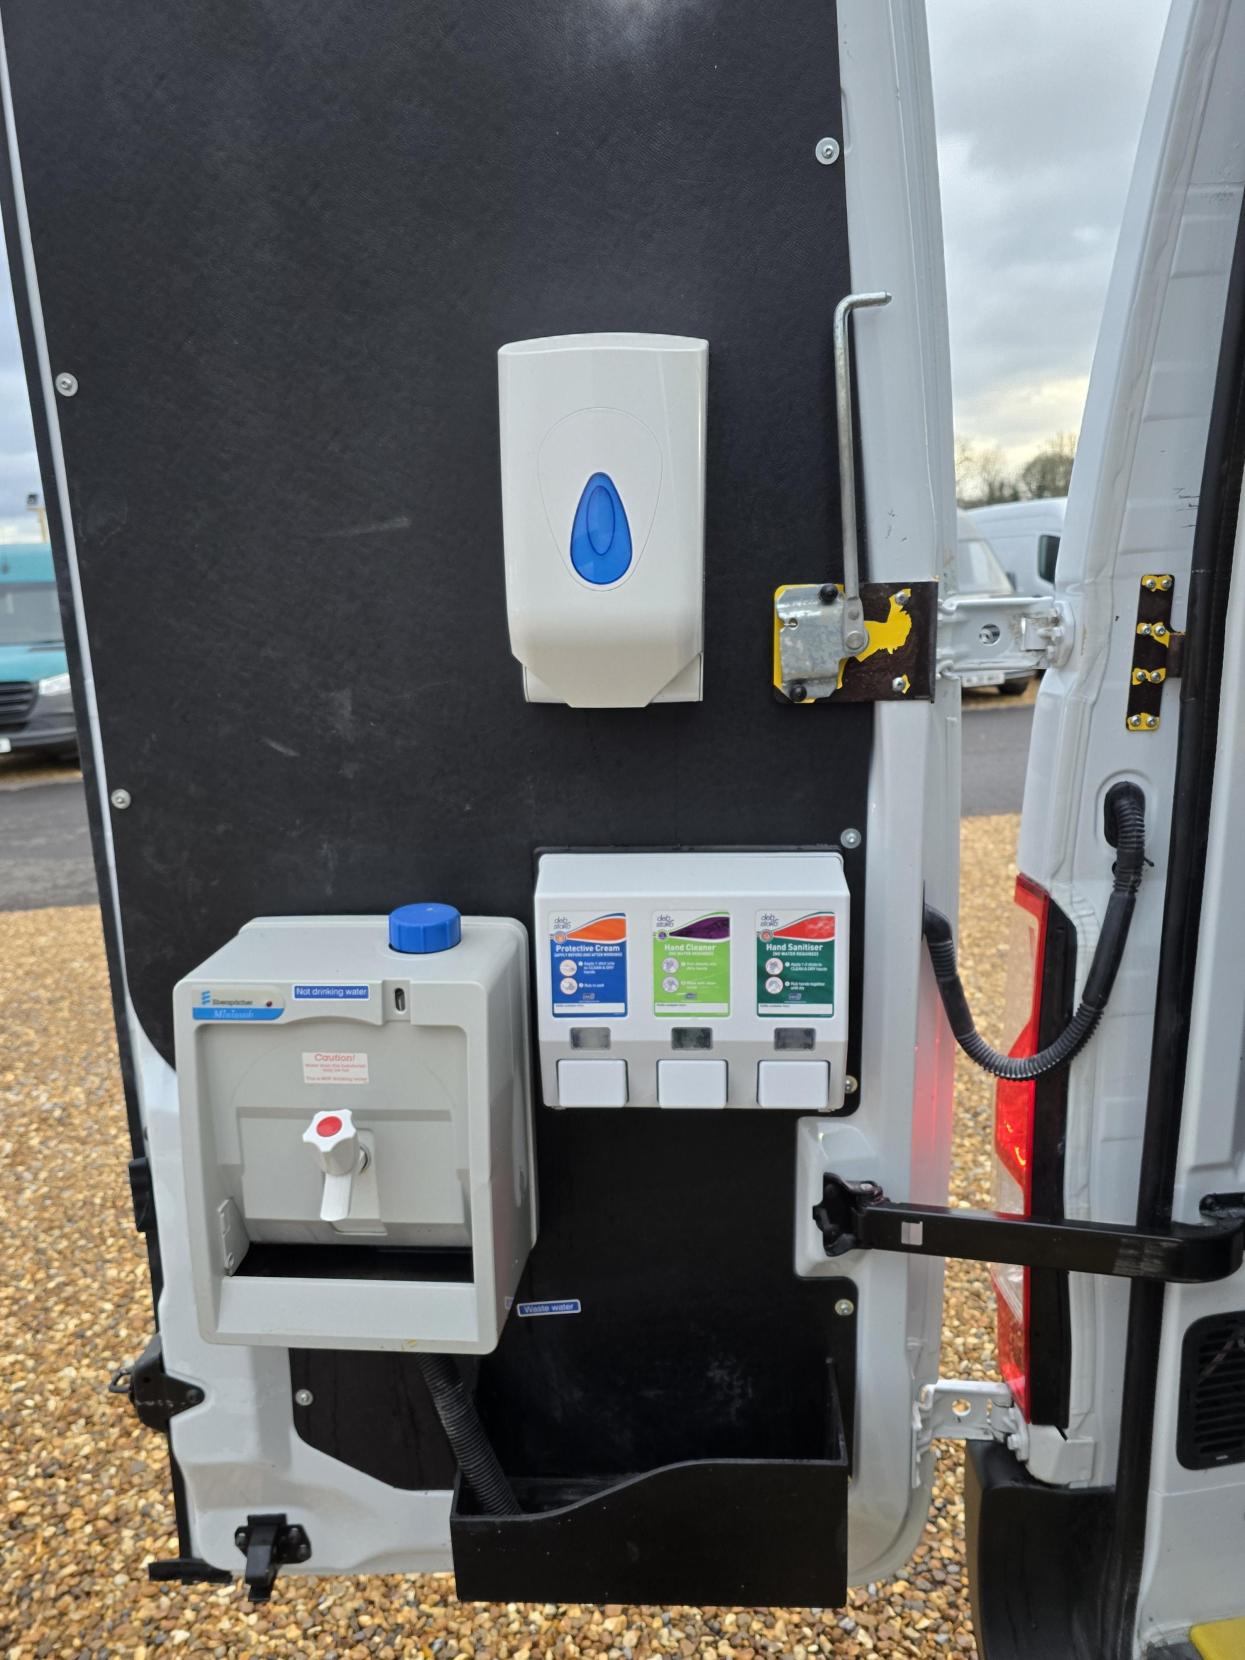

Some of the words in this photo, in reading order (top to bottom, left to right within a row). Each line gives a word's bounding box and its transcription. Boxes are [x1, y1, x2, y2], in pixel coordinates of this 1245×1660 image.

[664, 943, 685, 951] Hand
[685, 943, 716, 951] Cleaner
[766, 943, 787, 951] Hand
[788, 943, 823, 951] Sanitiser
[296, 987, 311, 996] Not
[312, 987, 344, 997] drinking
[345, 988, 367, 996] water
[314, 1053, 356, 1062] Caution!
[523, 1304, 550, 1314] Waste
[551, 1303, 574, 1311] water
